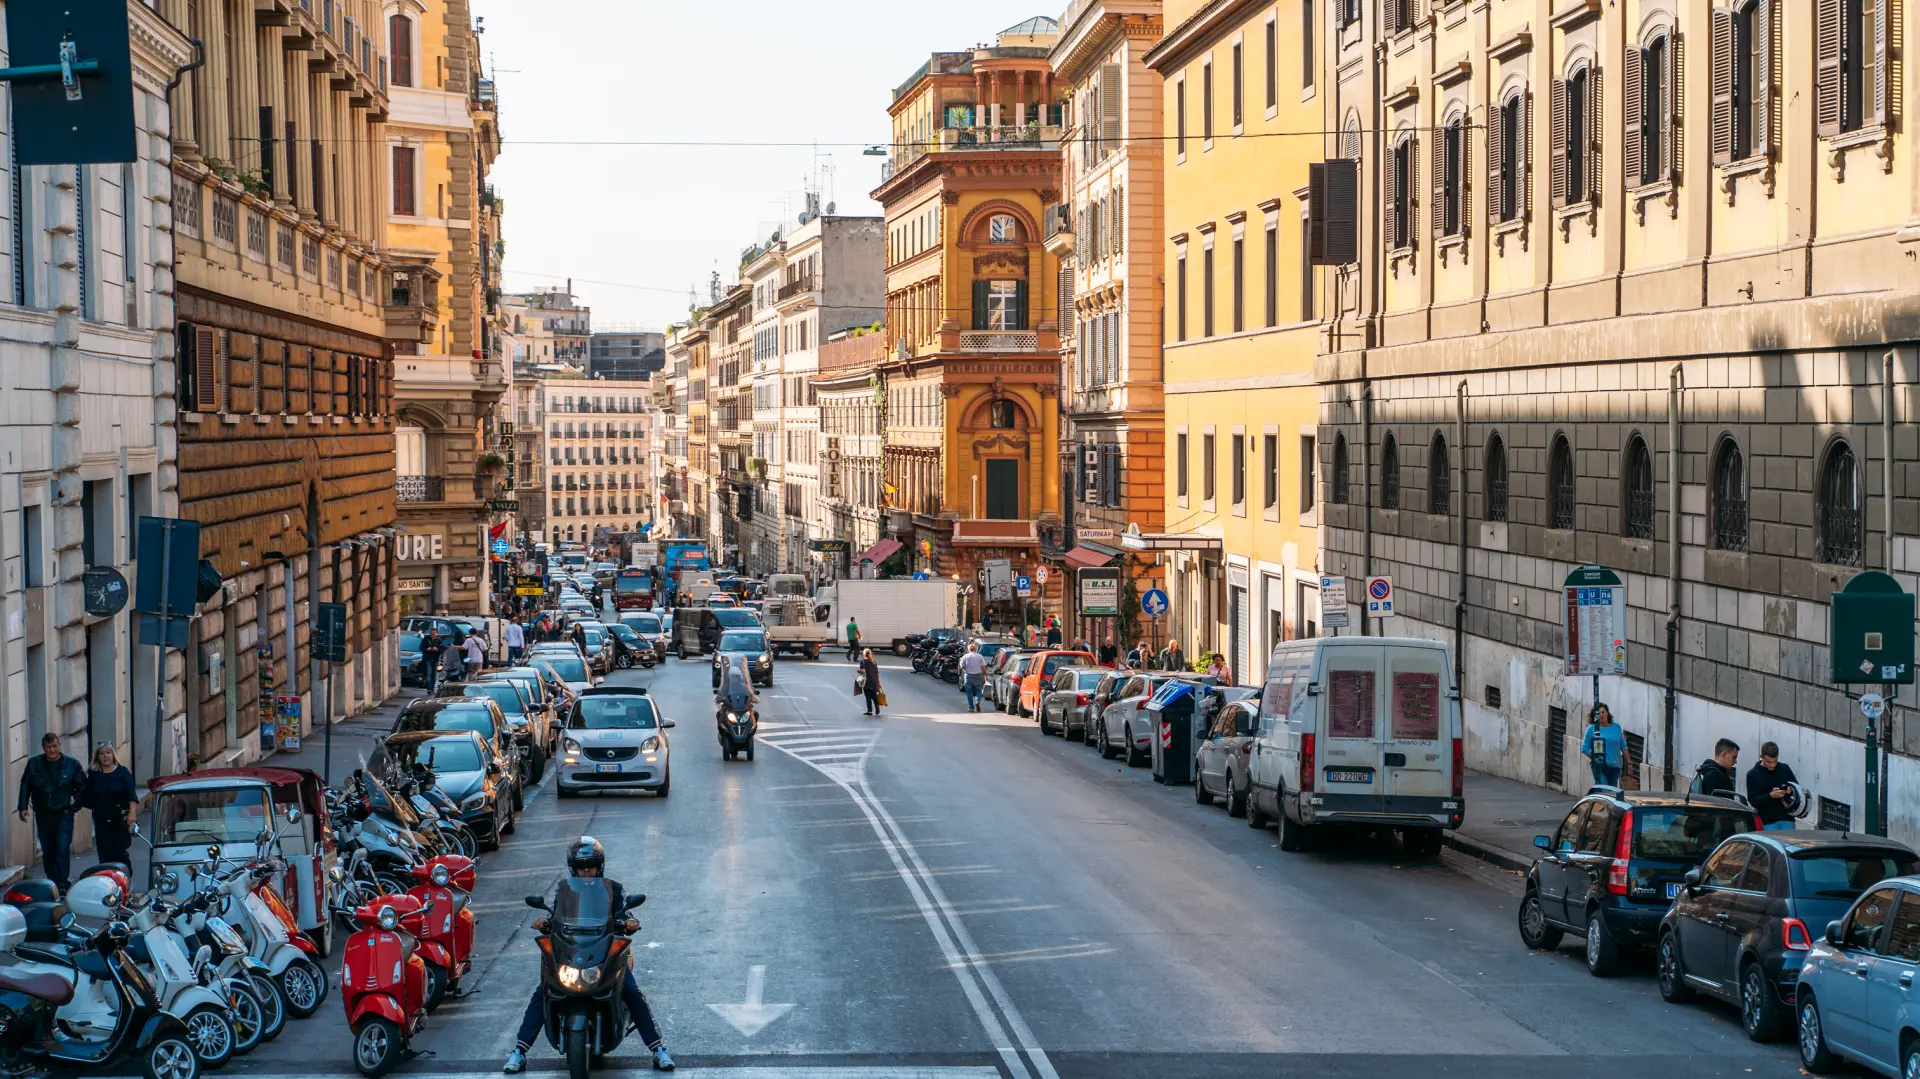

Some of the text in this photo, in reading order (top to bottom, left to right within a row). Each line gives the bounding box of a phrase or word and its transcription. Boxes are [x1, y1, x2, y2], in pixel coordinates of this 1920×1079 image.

[828, 437, 840, 498] HOTEL
[1085, 431, 1098, 522] HOTEL
[1079, 530, 1108, 538] SATURNIA
[396, 534, 442, 560] URE
[821, 543, 845, 551] Hotel
[1019, 578, 1027, 588] P
